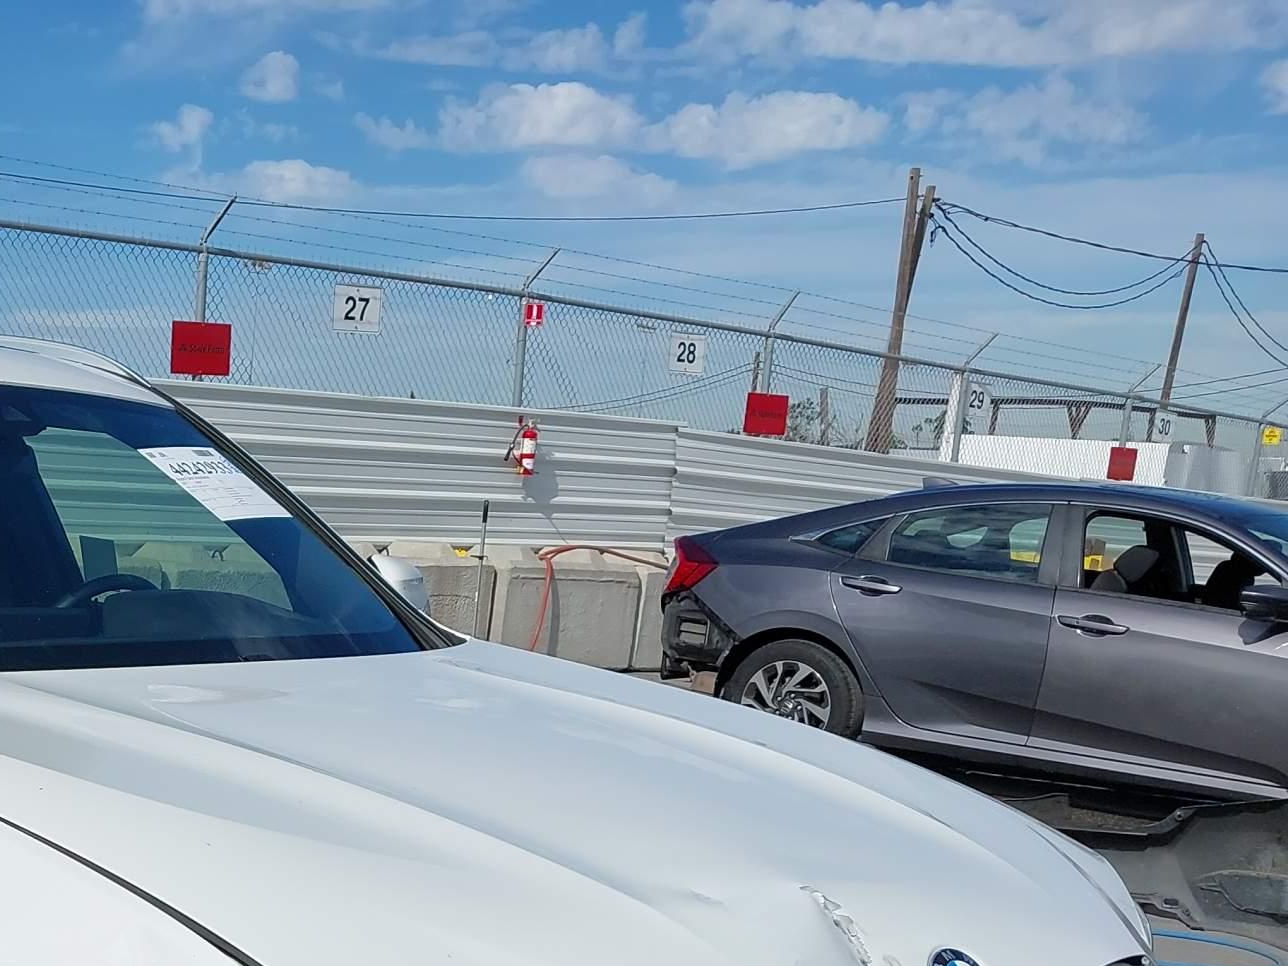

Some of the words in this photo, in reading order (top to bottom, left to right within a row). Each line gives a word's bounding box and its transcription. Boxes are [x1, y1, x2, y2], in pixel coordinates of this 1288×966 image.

[343, 295, 370, 322] 27
[676, 341, 697, 364] 28
[968, 389, 985, 410] 29
[1158, 417, 1171, 436] 30
[168, 460, 234, 476] 44242933
